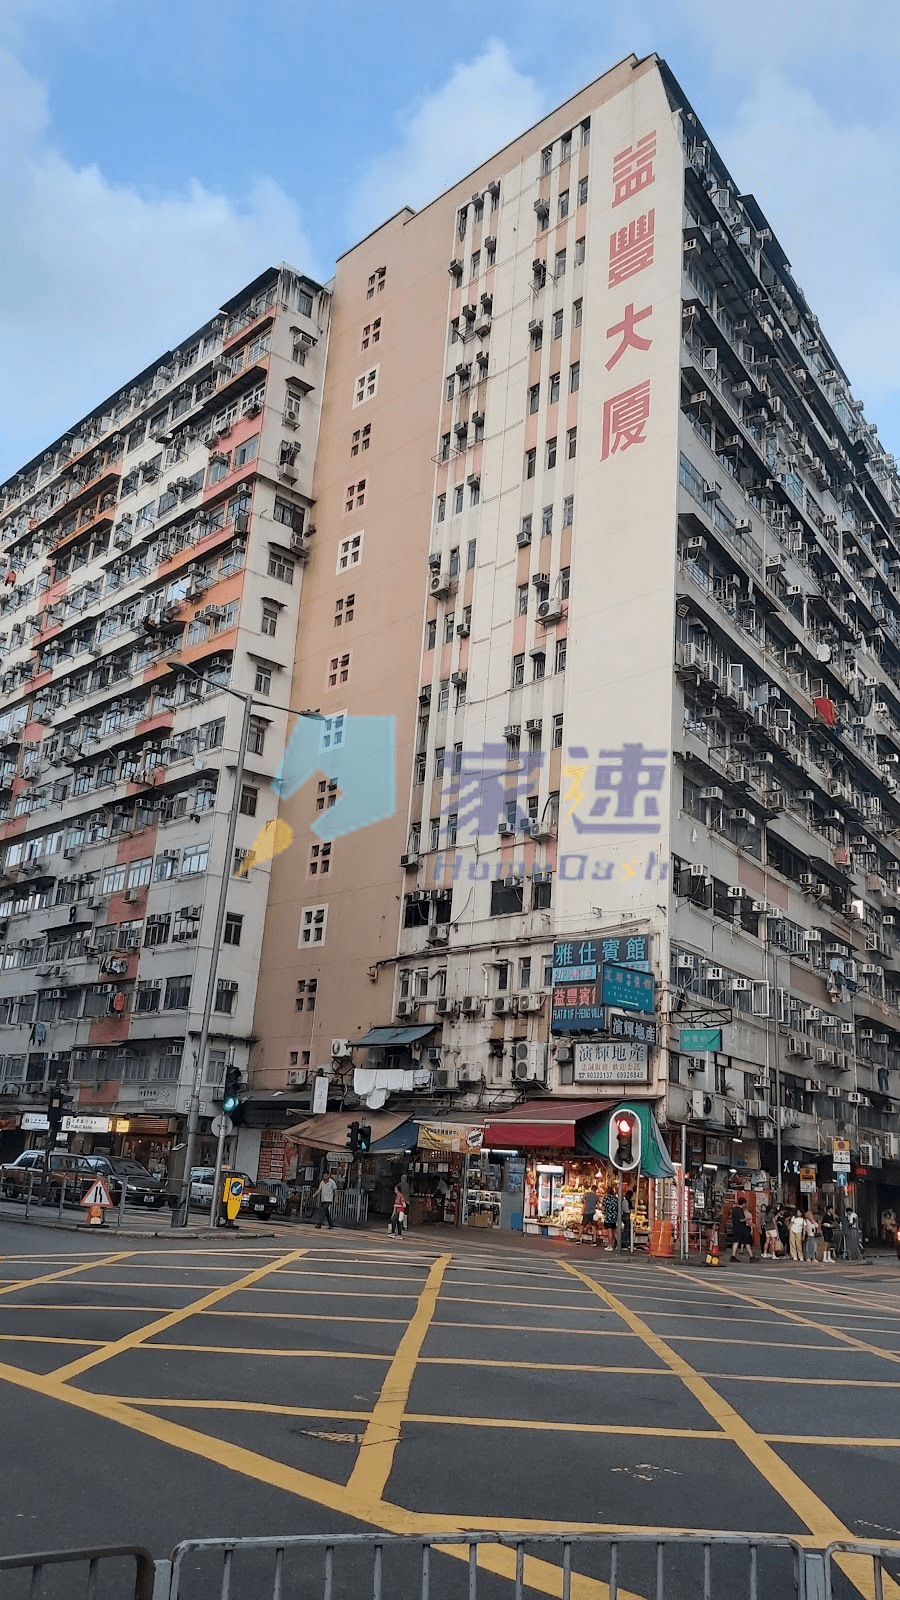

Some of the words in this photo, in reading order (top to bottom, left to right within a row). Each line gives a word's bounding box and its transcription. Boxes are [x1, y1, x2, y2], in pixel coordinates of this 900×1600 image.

[600, 129, 657, 462] 益豐大廈
[555, 937, 645, 966] 雅仕賓館
[612, 1017, 656, 1042] 演輝地產
[579, 1044, 644, 1061] 演輝地產
